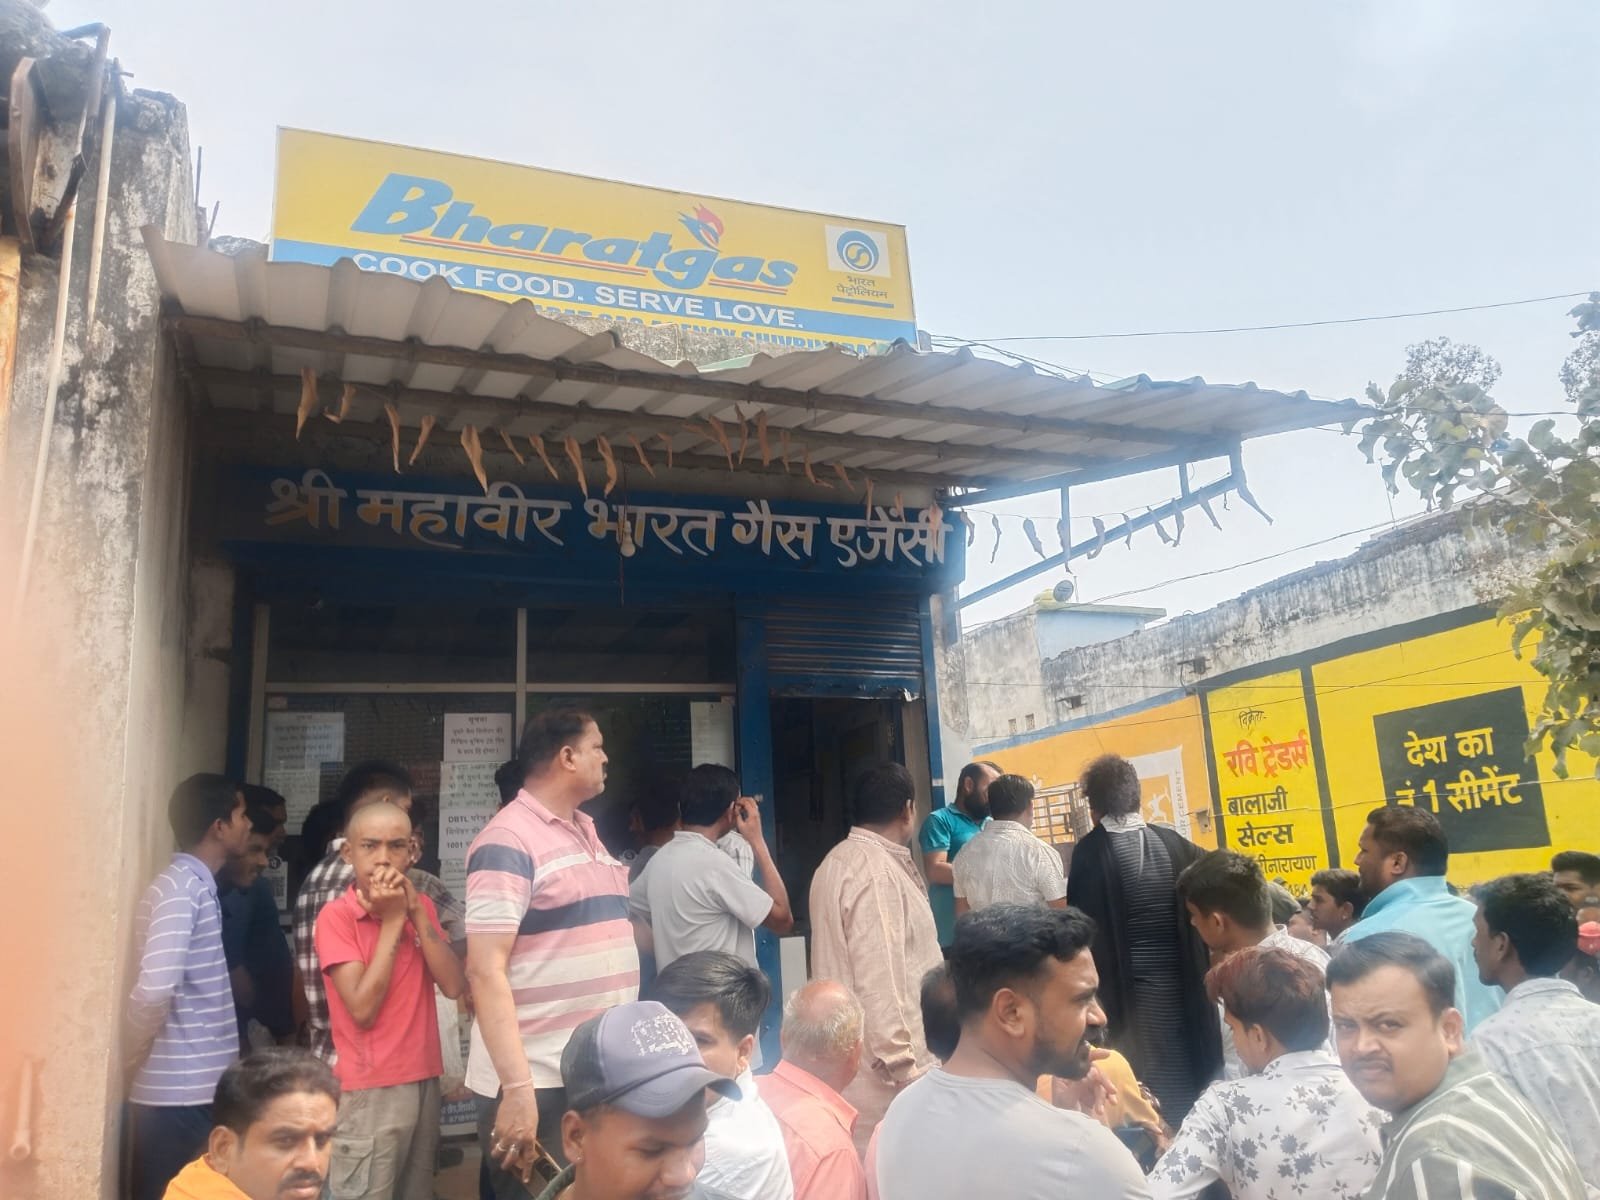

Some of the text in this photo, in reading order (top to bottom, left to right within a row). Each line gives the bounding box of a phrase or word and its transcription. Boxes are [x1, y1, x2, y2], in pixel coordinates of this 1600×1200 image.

[351, 173, 798, 290] Bharatgas
[353, 253, 464, 285] COOK
[475, 268, 584, 301] FOOD.
[595, 286, 704, 317] SERVE
[714, 301, 803, 328] LOVE.
[264, 469, 348, 529] श्री
[357, 481, 572, 549] महावीर
[584, 499, 725, 556] भारत
[732, 500, 821, 560] गैस
[1223, 729, 1310, 777] रवि ट्रेडर्स
[1404, 727, 1494, 767] देश का
[1227, 785, 1288, 816] बालाजी
[1423, 779, 1439, 813] 1
[1445, 765, 1522, 813] सीमेंट
[1237, 821, 1294, 847] सेल्स
